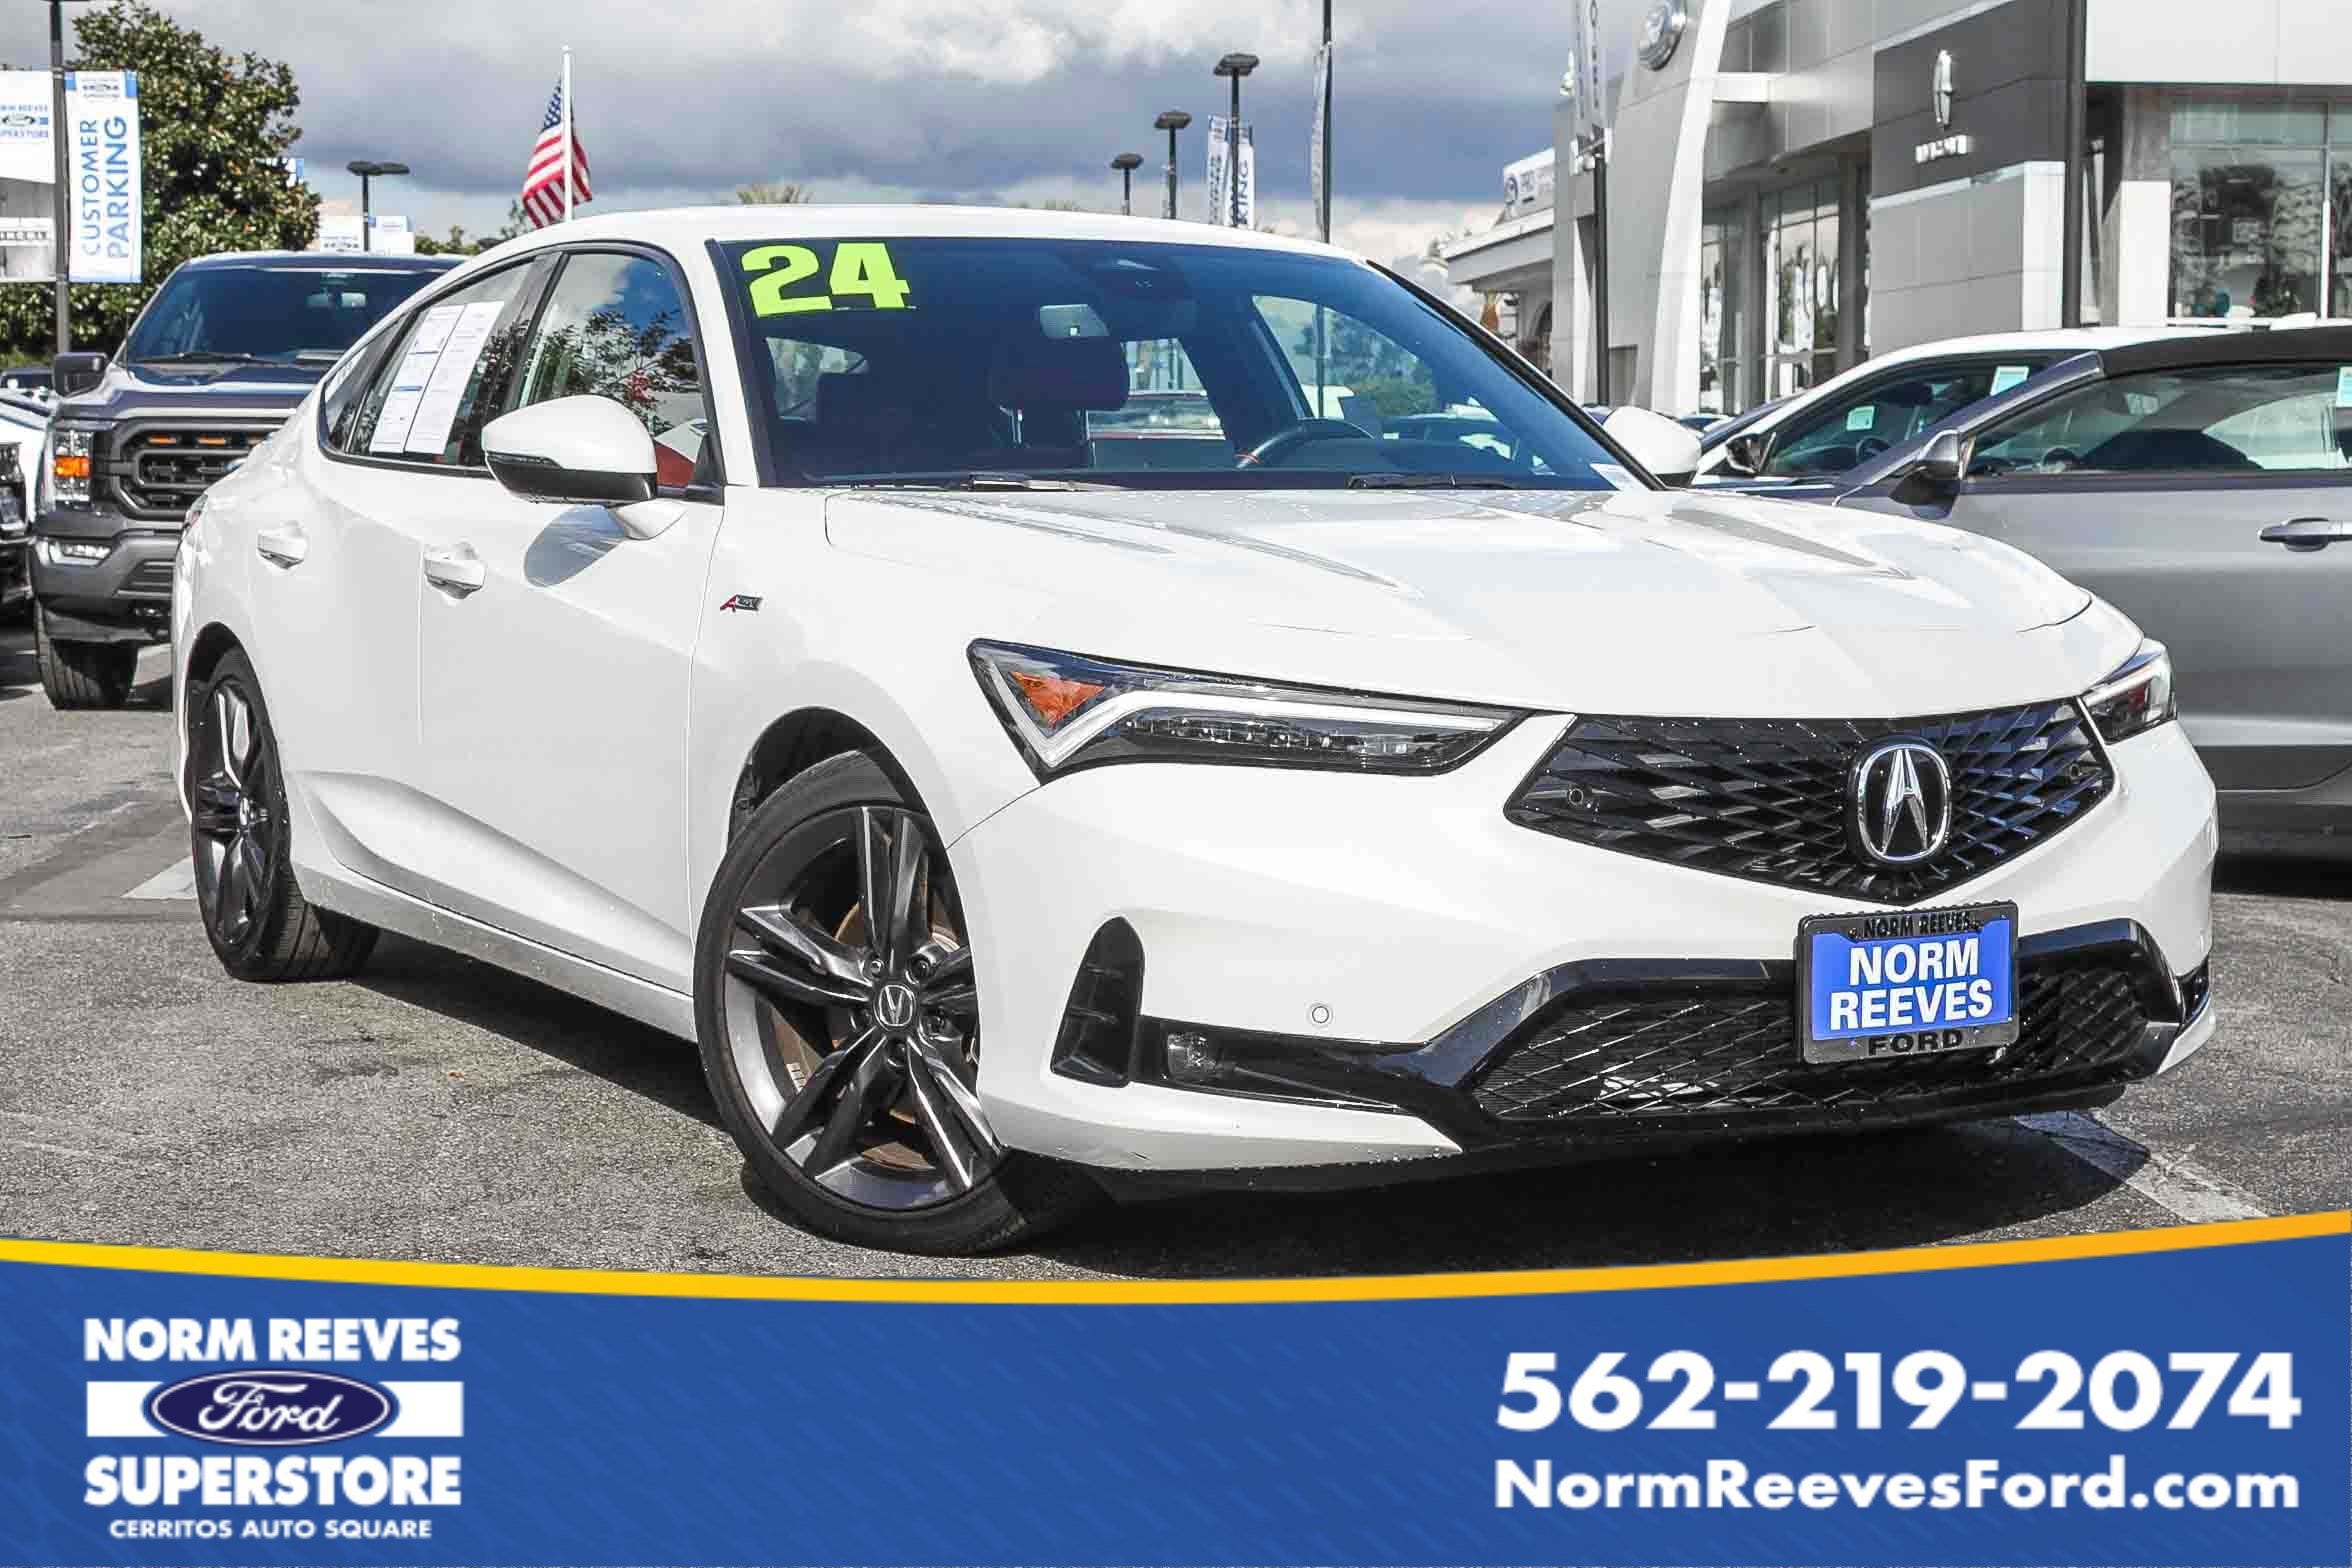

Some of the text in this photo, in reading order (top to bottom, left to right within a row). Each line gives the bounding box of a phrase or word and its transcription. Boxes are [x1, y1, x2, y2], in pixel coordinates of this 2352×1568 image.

[80, 119, 101, 256] CUSTOMER
[104, 116, 129, 258] PARKING
[741, 242, 911, 318] 24
[1863, 910, 1972, 939] NORM REEVES
[1849, 938, 1979, 985] NORM
[1830, 978, 1993, 1031] REEVES
[1868, 1030, 1964, 1056] FORD
